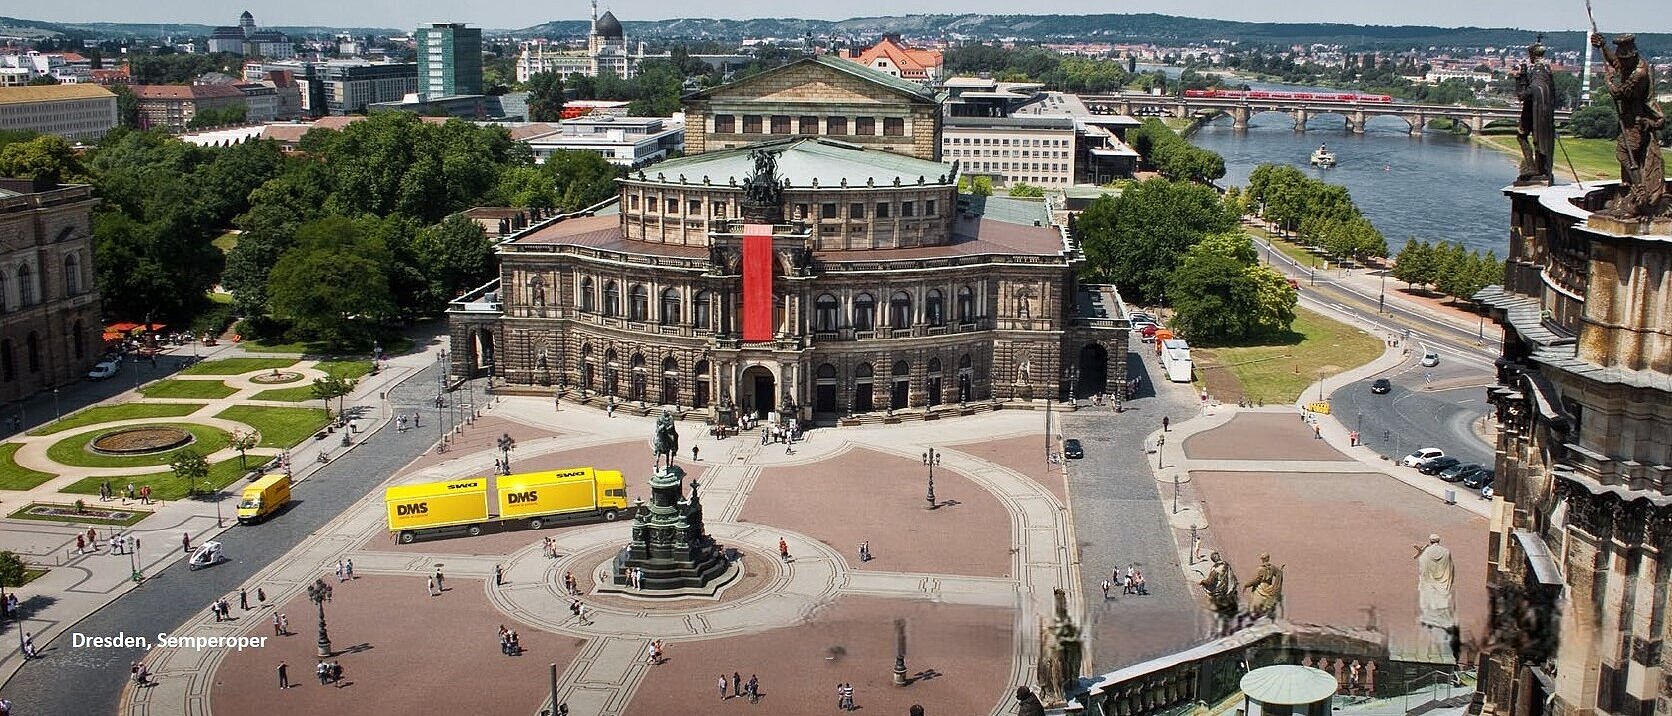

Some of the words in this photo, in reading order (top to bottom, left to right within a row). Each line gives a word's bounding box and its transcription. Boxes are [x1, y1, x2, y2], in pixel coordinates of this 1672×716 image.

[556, 471, 585, 479] DMS
[508, 490, 538, 504] DMS
[397, 502, 428, 516] DMS
